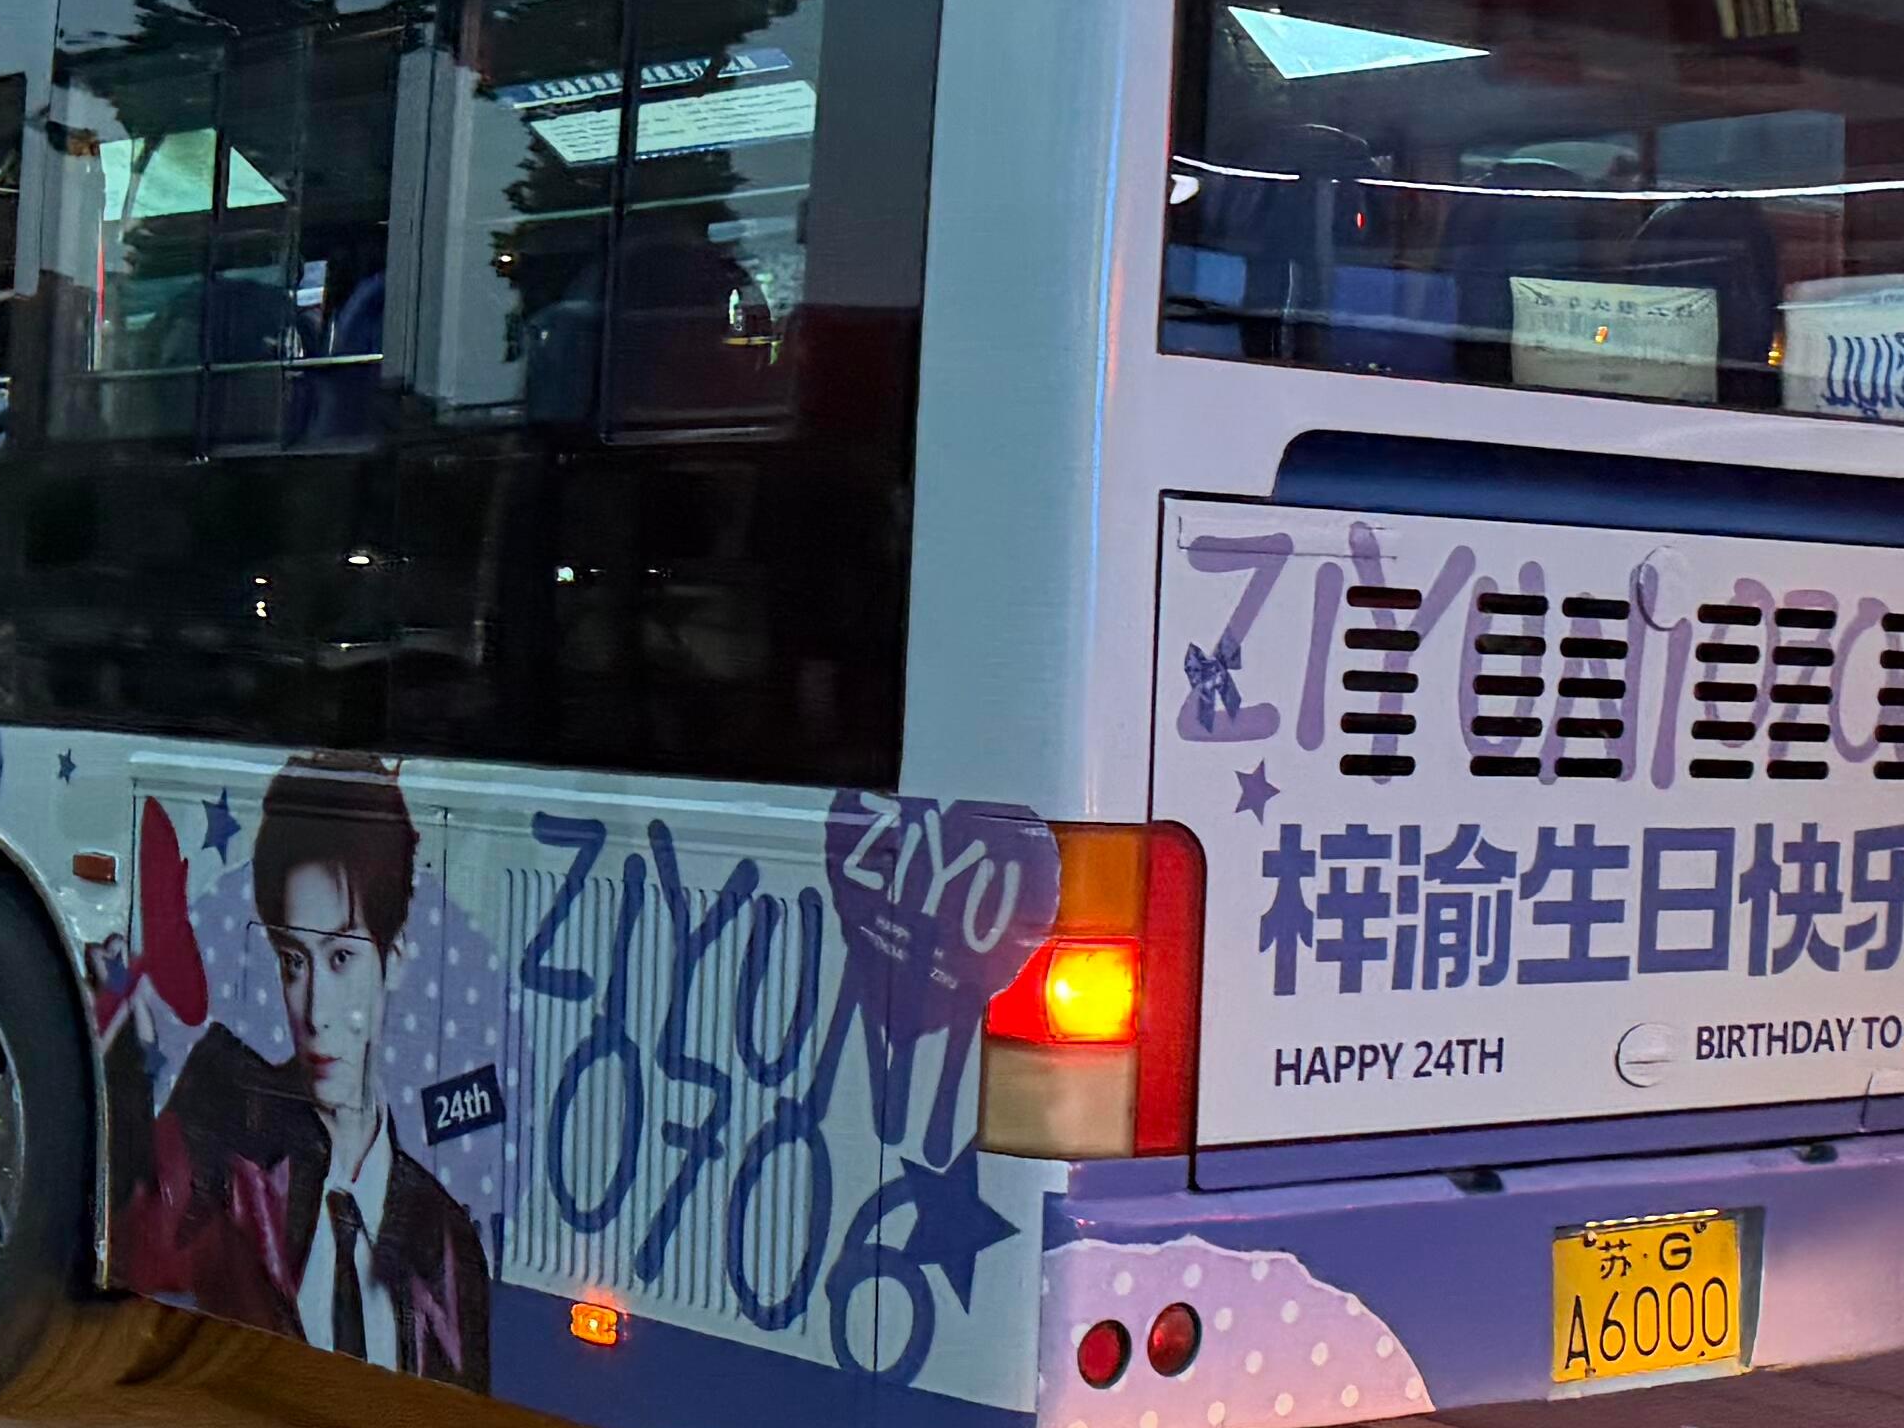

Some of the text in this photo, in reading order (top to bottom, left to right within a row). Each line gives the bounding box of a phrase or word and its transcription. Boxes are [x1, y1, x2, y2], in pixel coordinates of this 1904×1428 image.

[843, 791, 1021, 954] ZIYU
[1274, 1042, 1402, 1086] HAPPY
[1413, 1037, 1505, 1079] 24TH
[1695, 1016, 1855, 1060] BIRTHDAY
[1861, 1015, 1900, 1048] TO
[433, 1082, 492, 1131] 24th
[1564, 1277, 1729, 1370] A6000
